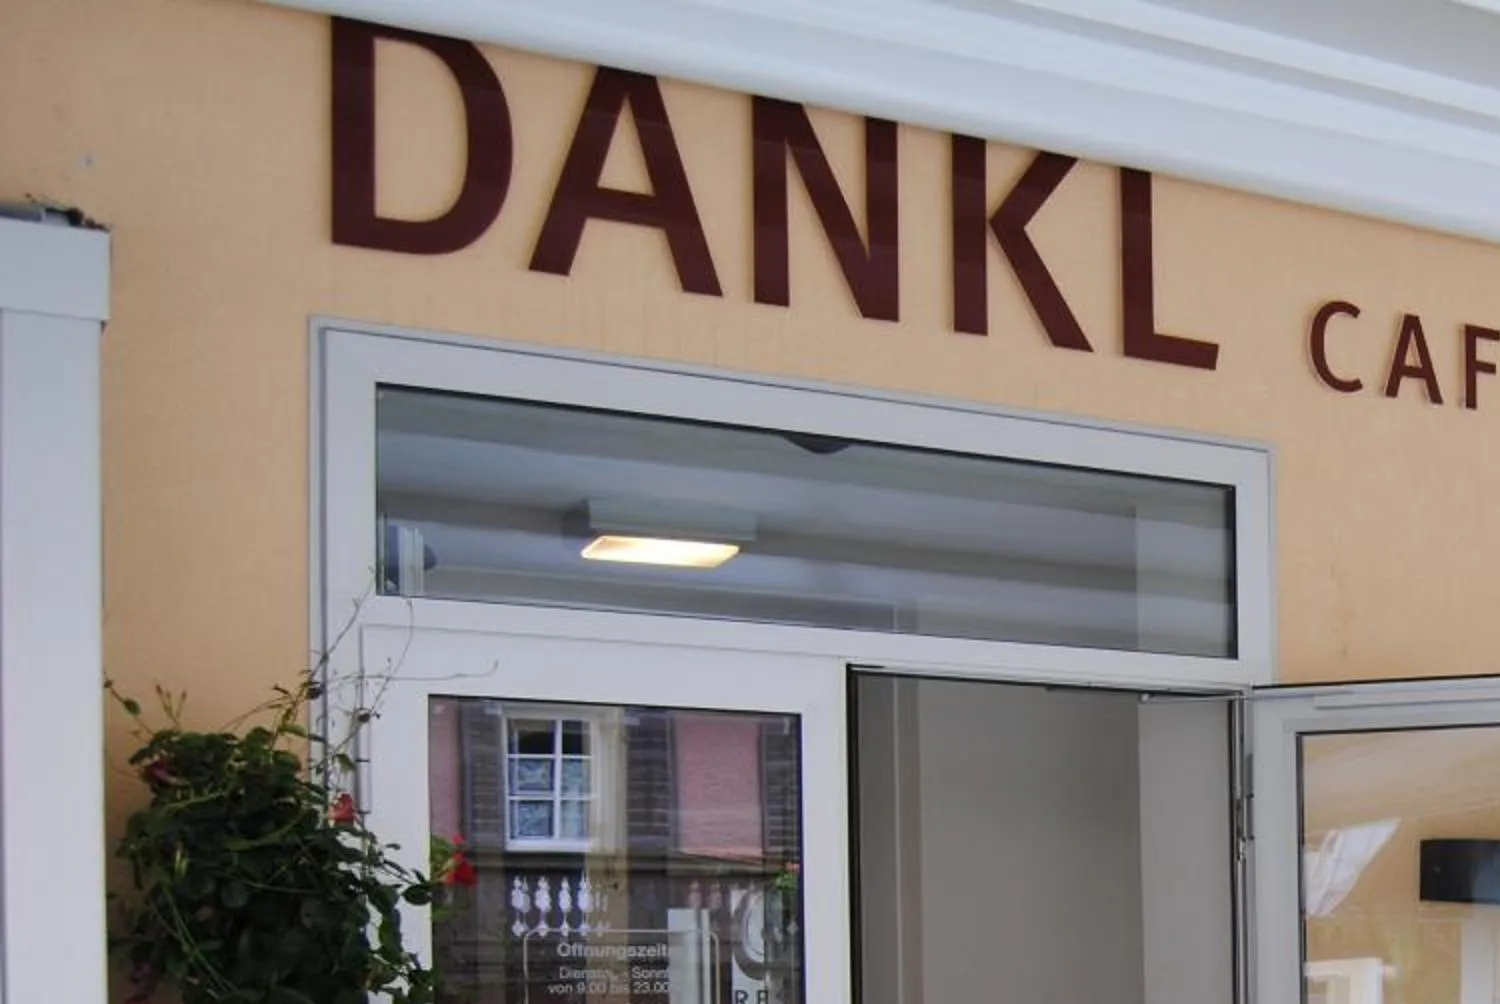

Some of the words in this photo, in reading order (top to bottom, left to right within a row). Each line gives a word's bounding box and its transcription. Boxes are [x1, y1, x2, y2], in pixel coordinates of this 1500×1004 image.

[331, 16, 1220, 371] DANKL
[556, 940, 669, 960] Öffnungszeit
[547, 983, 574, 995] von
